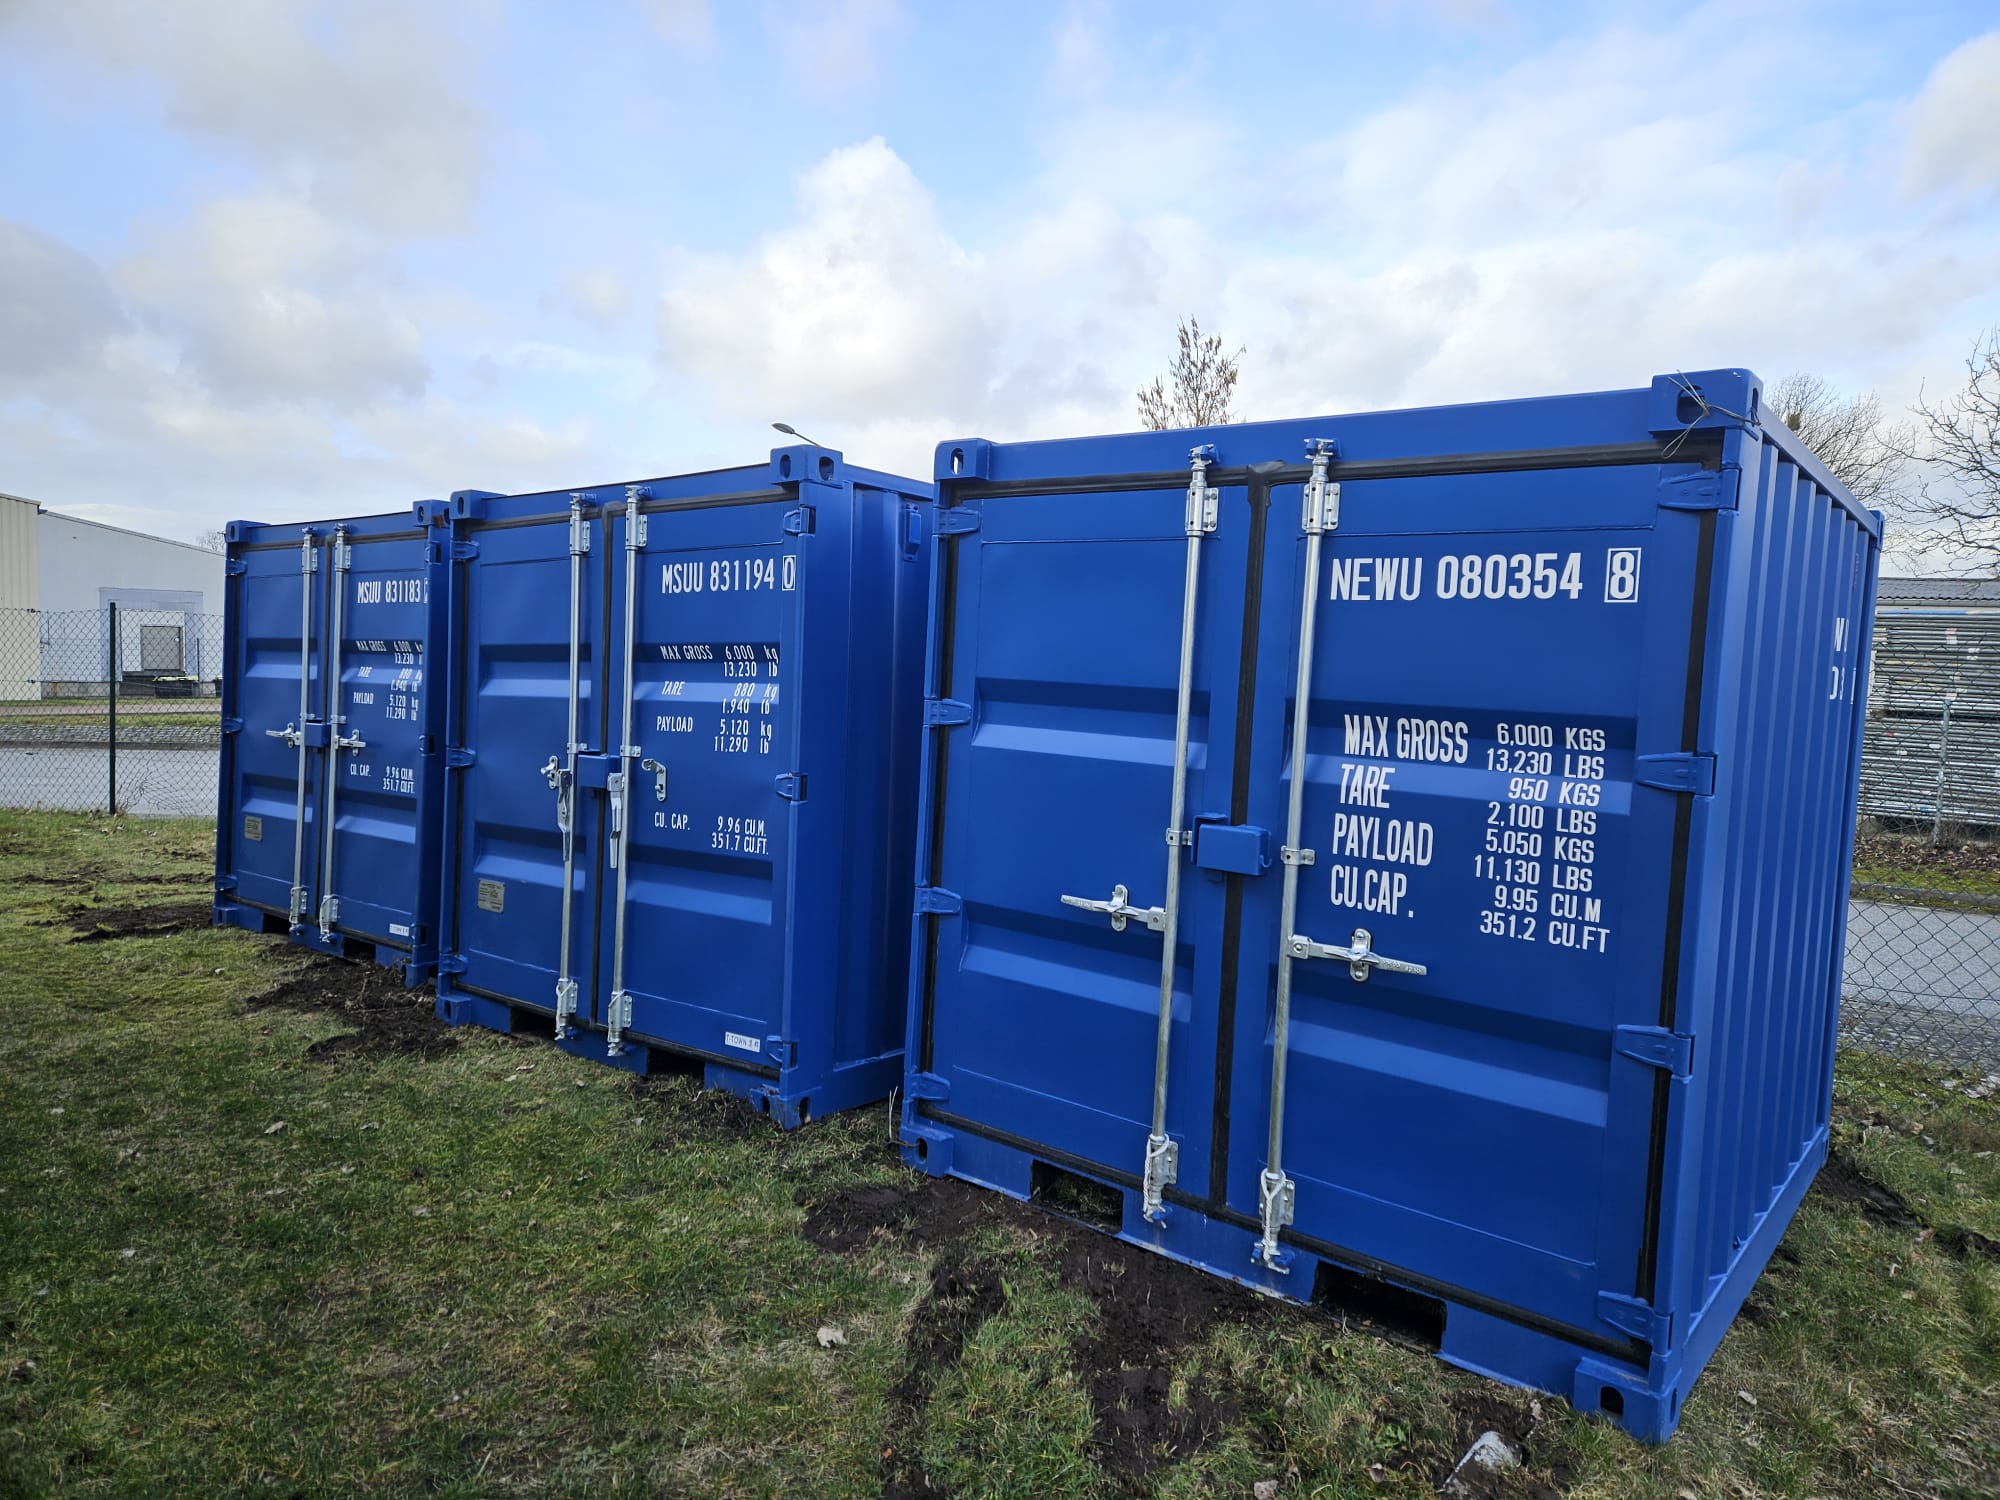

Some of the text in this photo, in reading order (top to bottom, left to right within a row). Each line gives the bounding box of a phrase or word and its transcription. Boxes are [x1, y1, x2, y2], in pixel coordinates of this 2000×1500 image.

[662, 557, 795, 593] MSUU 831194 0
[1331, 551, 1637, 600] NEWU 080354 8
[358, 581, 381, 603] MSUU
[385, 580, 420, 603] 831183
[395, 652, 414, 665] 13.230
[660, 645, 779, 663] MAX GROSS 6.000 kg
[724, 661, 778, 677] 13.230 lb
[353, 692, 418, 711] PAYLOAD 5.120 kg
[662, 681, 777, 701] TARE 880 kg
[386, 706, 405, 719] 11.290
[722, 698, 770, 714] 1.940 lb
[656, 716, 772, 741] PAYLOAD 5.120 kg
[1344, 714, 1389, 758] MAX
[1397, 718, 1468, 763] GROSS
[1565, 727, 1606, 751] KGS
[714, 736, 769, 753] 11.290 lb
[360, 764, 371, 776] CAP.
[385, 766, 399, 779] 9.96
[1564, 754, 1604, 780] LBS
[383, 778, 399, 791] 351.7
[1339, 763, 1601, 808] TARE 950 KGS
[654, 812, 767, 837] CU. CAP. 9.96 CU.M.
[1556, 808, 1597, 835] LBS
[711, 832, 769, 855] 351.7 CU.FT.
[1332, 813, 1433, 866] PAYLOAD
[1554, 836, 1595, 863] KGS
[1552, 864, 1593, 892] LBS
[1494, 885, 1538, 913] 9.95
[1550, 893, 1601, 923] CU.M
[1480, 910, 1610, 953] 351.2 CU.FT
